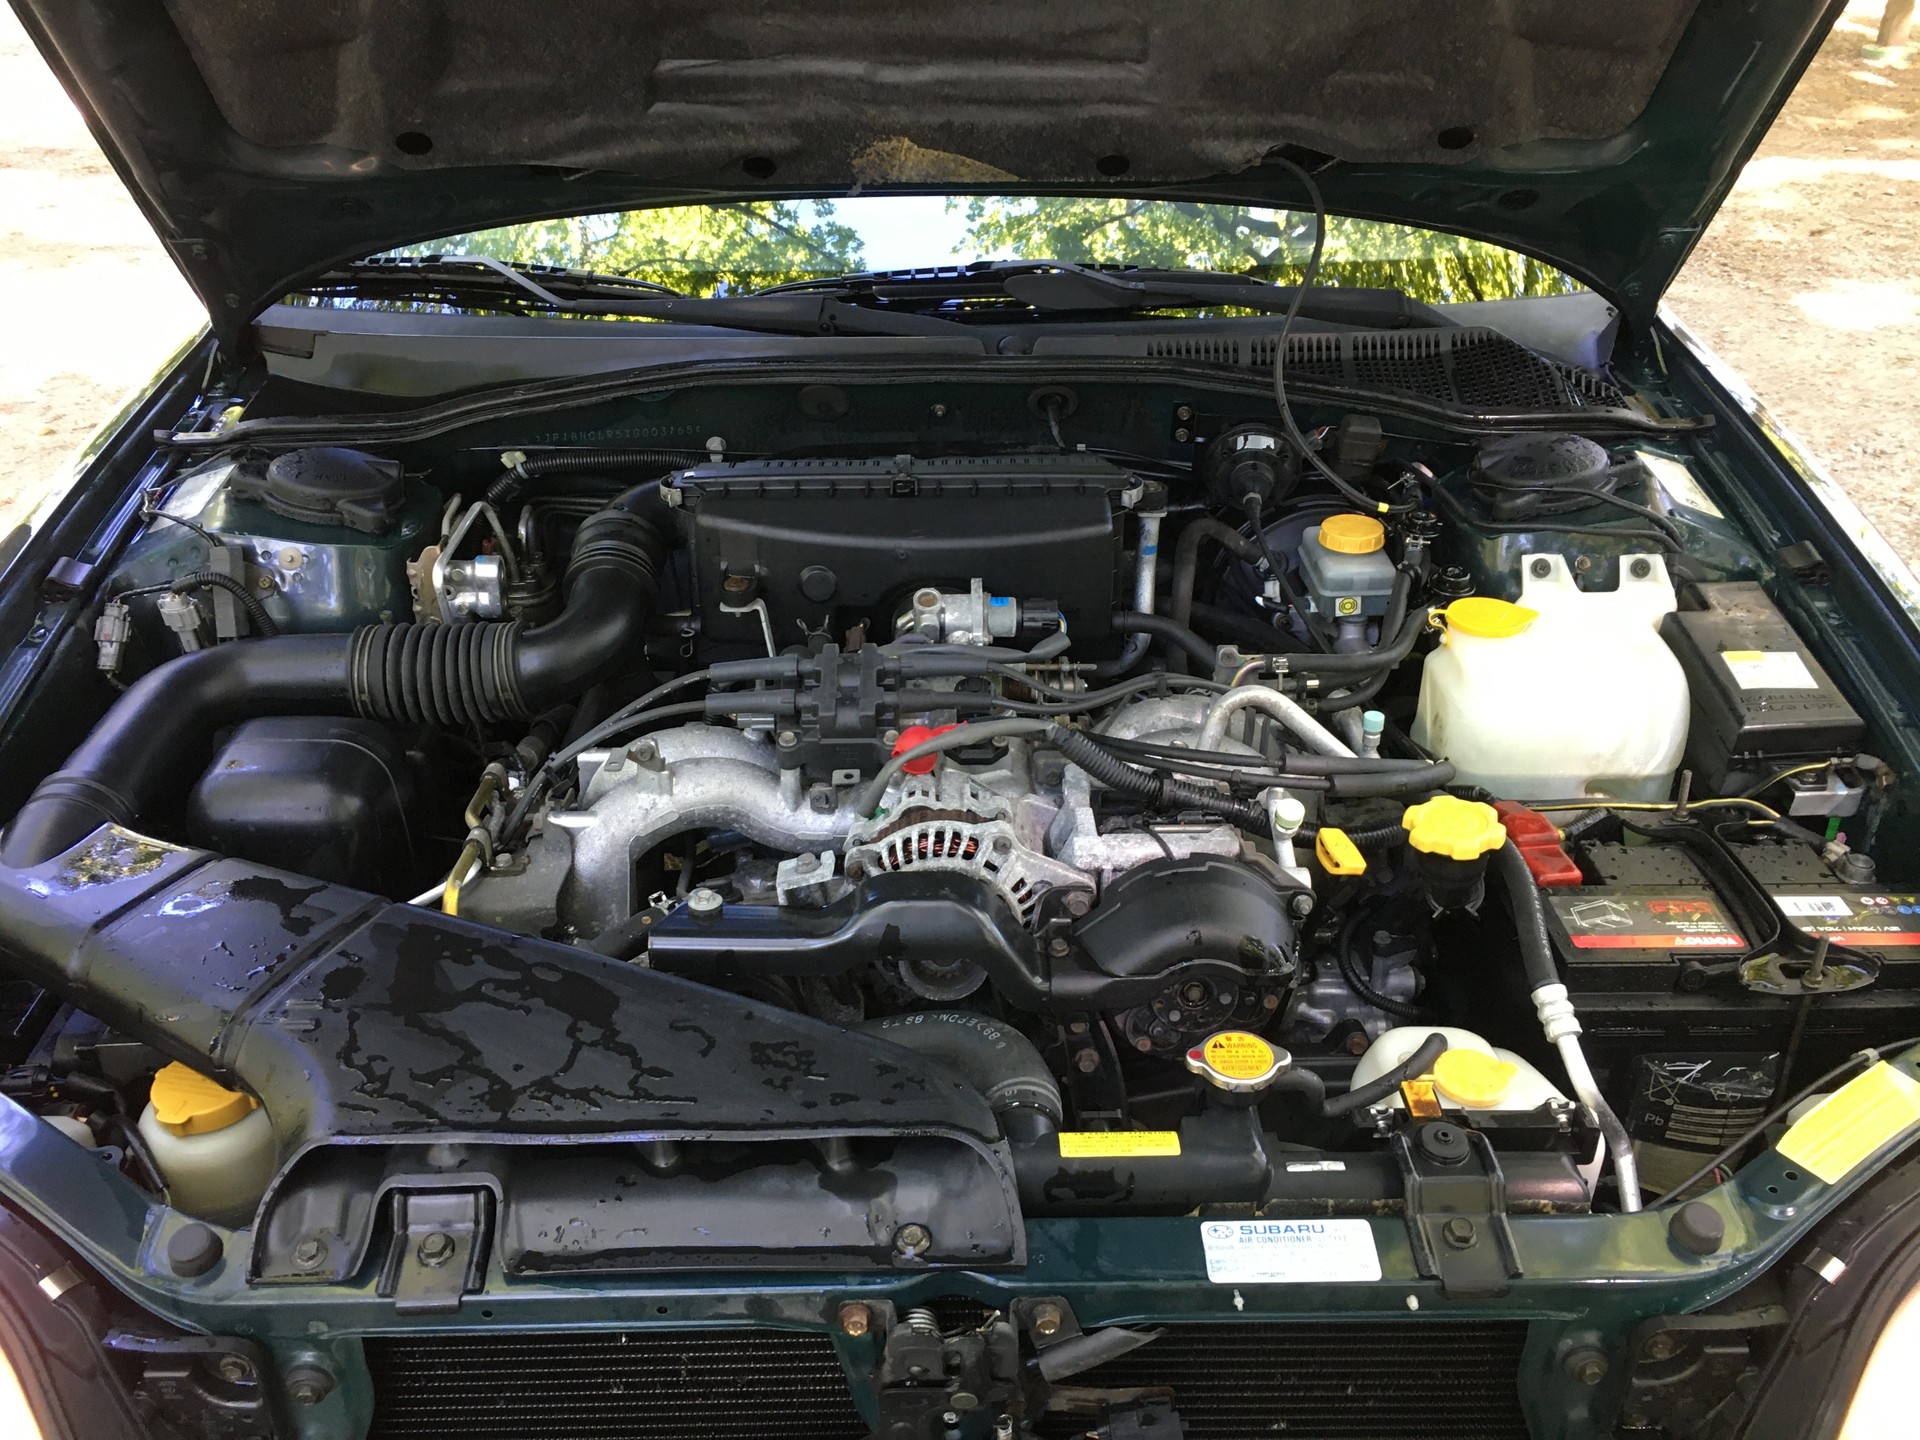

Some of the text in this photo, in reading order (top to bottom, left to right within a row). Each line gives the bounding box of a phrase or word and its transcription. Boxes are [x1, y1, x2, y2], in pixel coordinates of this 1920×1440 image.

[1643, 1113, 1664, 1126] Pb
[1240, 1224, 1325, 1235] SUBARU
[1256, 1235, 1312, 1243] CONDITIONER
